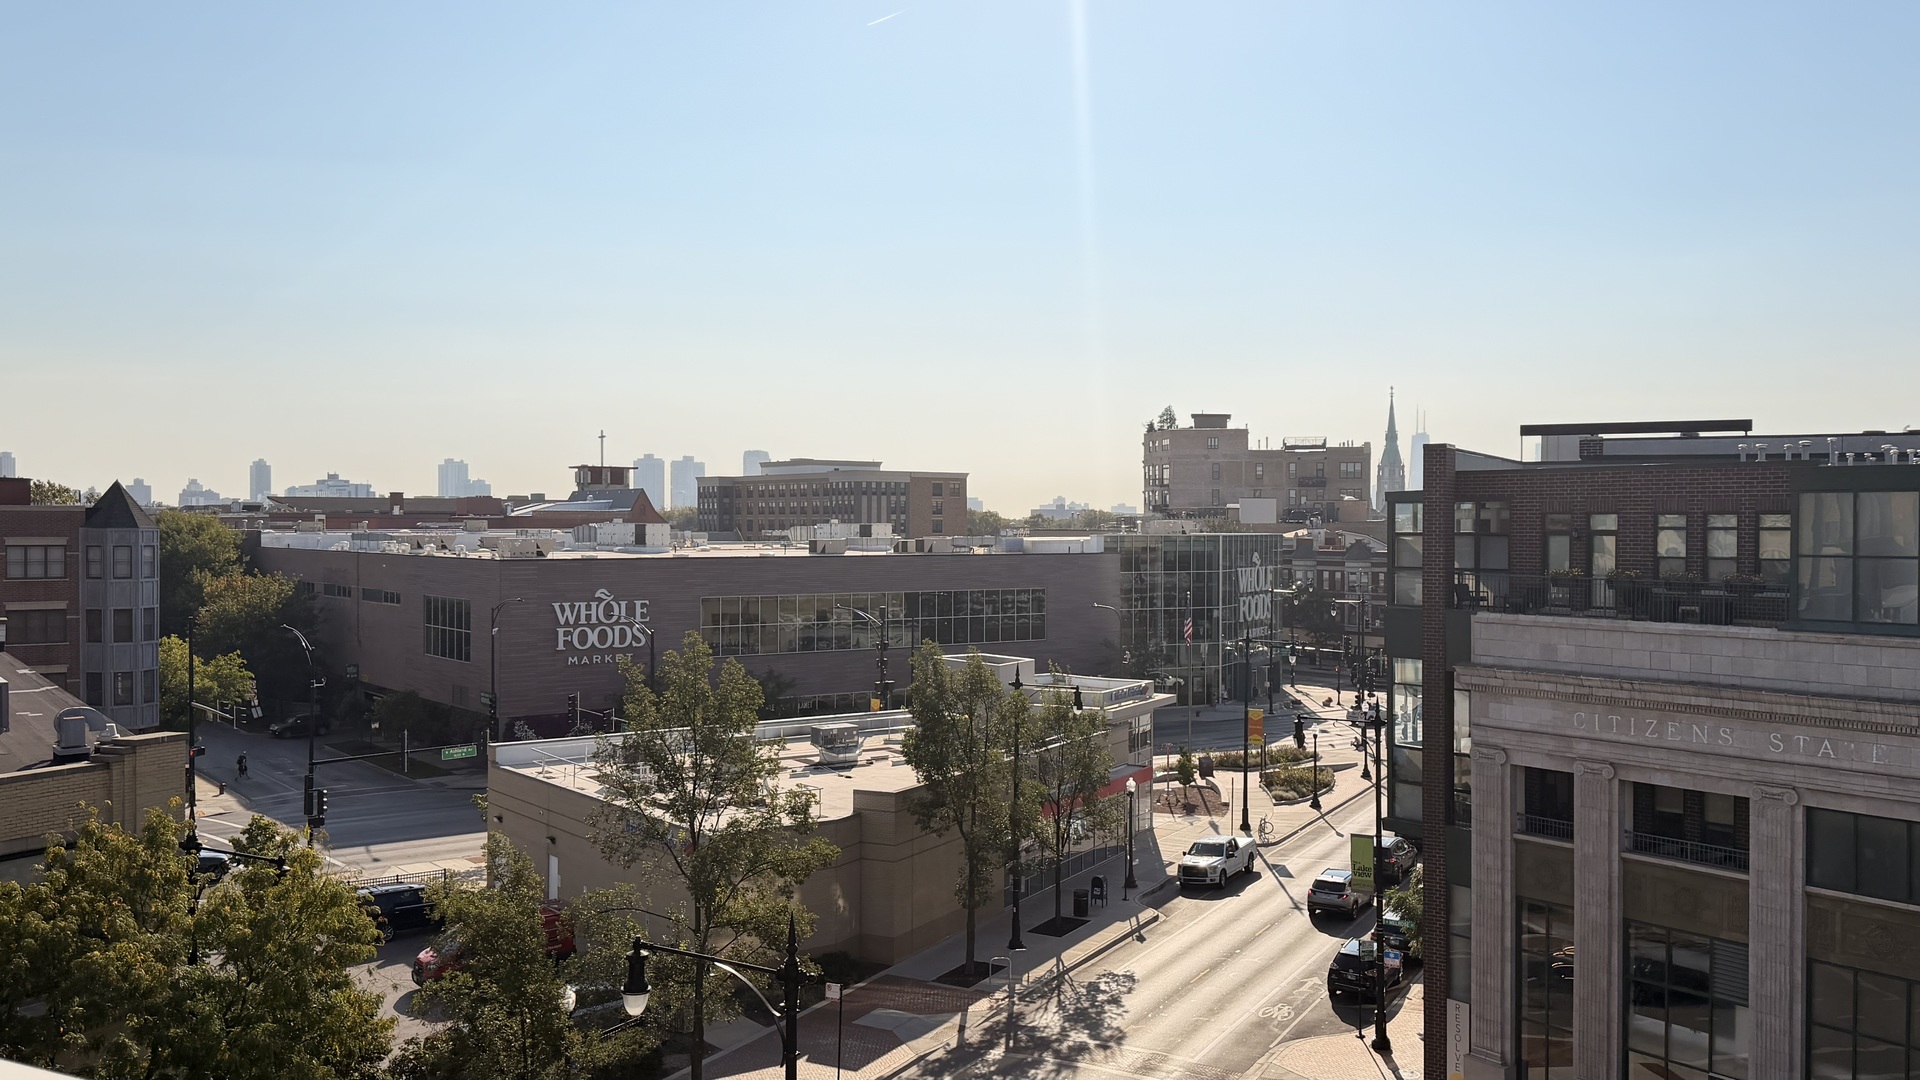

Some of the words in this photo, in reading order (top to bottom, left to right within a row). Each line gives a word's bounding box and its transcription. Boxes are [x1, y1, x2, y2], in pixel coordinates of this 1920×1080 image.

[1237, 566, 1273, 593] WHOLE
[552, 599, 650, 626] WHOLE
[1239, 593, 1271, 622] FOODS
[556, 625, 646, 651] FOODS
[1574, 712, 1733, 745] CITIZENS
[1769, 733, 1888, 764] STAE
[1353, 864, 1372, 872] Lake
